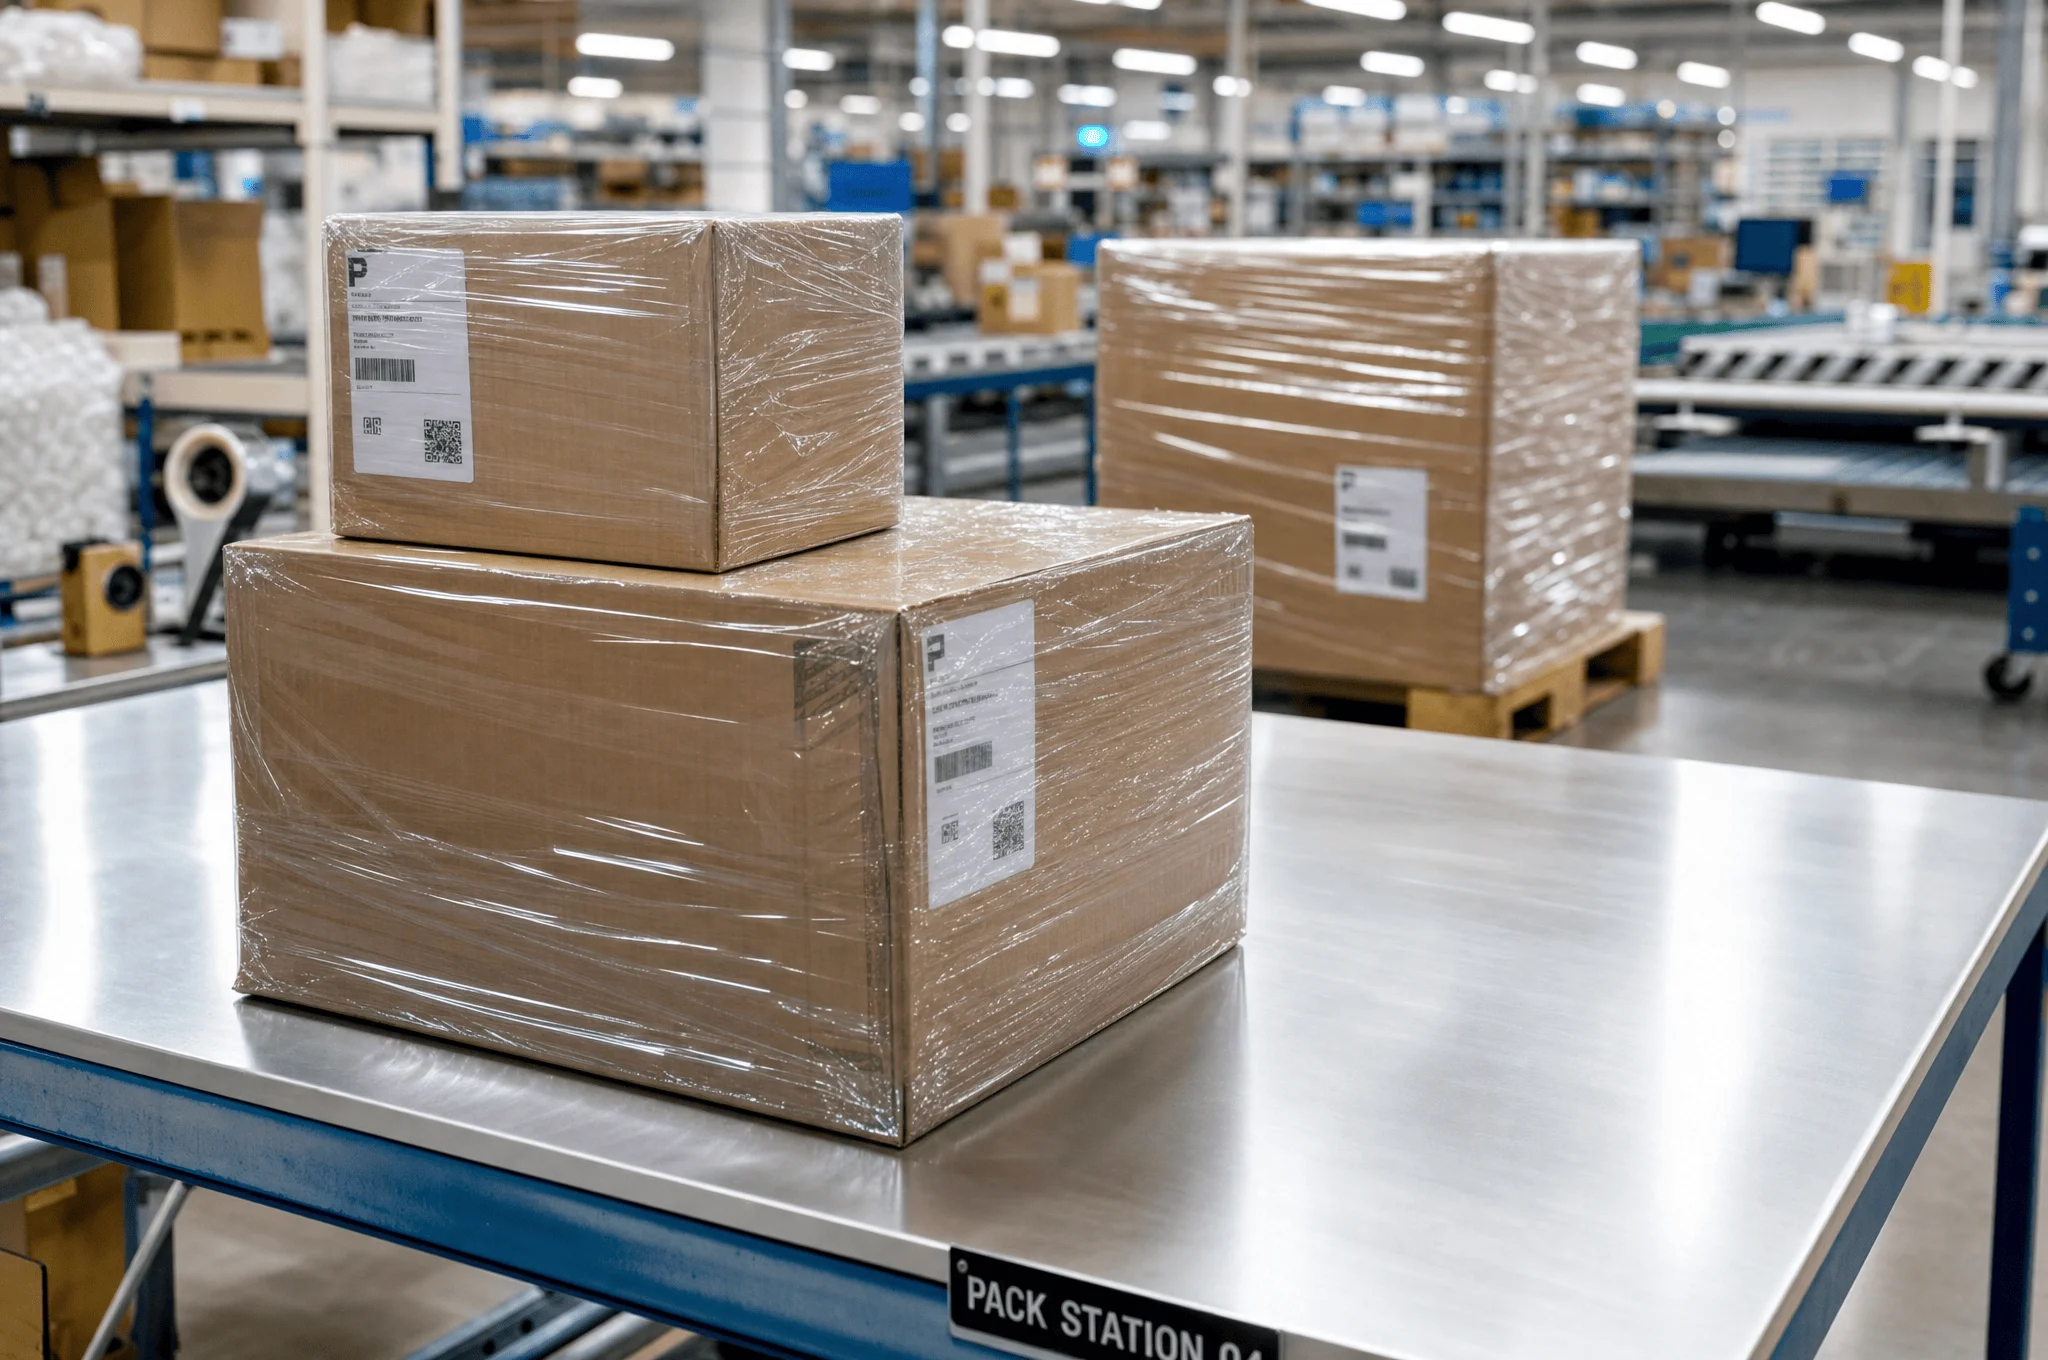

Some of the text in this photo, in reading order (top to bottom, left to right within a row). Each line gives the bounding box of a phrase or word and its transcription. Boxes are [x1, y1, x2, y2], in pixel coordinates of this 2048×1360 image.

[348, 257, 368, 287] P
[927, 634, 945, 672] P
[968, 1275, 1048, 1330] PACK
[1060, 1299, 1203, 1360] STATION
